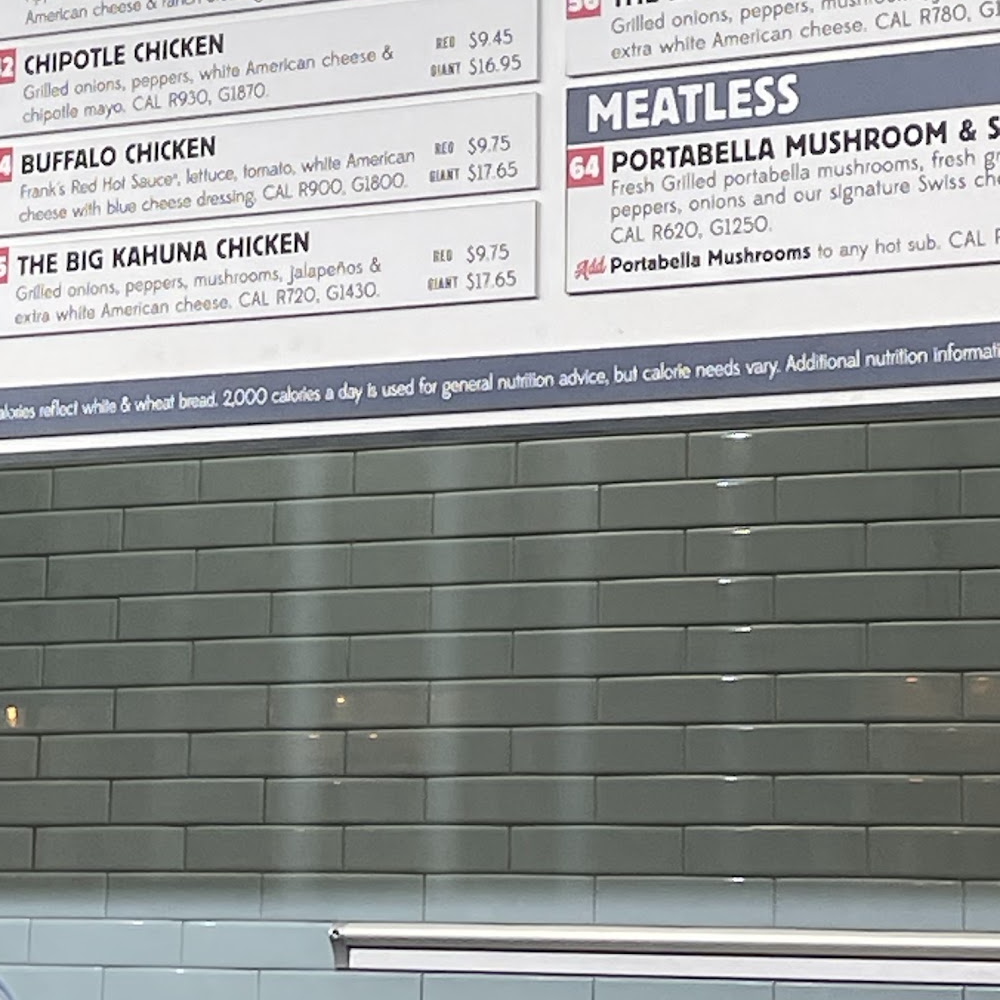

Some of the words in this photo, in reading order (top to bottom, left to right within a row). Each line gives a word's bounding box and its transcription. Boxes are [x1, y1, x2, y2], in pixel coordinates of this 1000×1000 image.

[24, 44, 126, 76] CHIPOTLE
[134, 33, 224, 63] CHICKEN
[468, 28, 513, 50] $9.45
[468, 53, 522, 76] $16.95
[588, 73, 799, 133] MEATLESS
[21, 145, 116, 175] BUFFALO
[125, 135, 216, 165] CHICKEN
[467, 134, 511, 156] $9.75
[570, 154, 600, 180] 64
[611, 137, 775, 174] PORTABELLA
[786, 120, 947, 159] MUSHROOM
[958, 118, 977, 142] &
[467, 160, 519, 183] $17.65
[17, 252, 58, 276] THE
[66, 248, 103, 273] BIG
[112, 240, 208, 269] KAHUNA
[216, 231, 310, 260] CHICKEN
[466, 243, 510, 264] $9.75
[574, 256, 606, 281] Add
[610, 250, 701, 274] Portabella
[708, 246, 811, 267] Mushrooms
[817, 245, 833, 258] to
[839, 245, 868, 260] any
[875, 239, 901, 253] hot
[908, 235, 939, 252] sub.
[466, 269, 517, 292] $17.65
[558, 367, 610, 387] advice,
[613, 364, 638, 384] but
[642, 361, 692, 382] calorie
[695, 357, 741, 378] needs
[745, 360, 782, 381] vary.
[785, 348, 861, 373] Additional
[865, 348, 929, 367] nutrition
